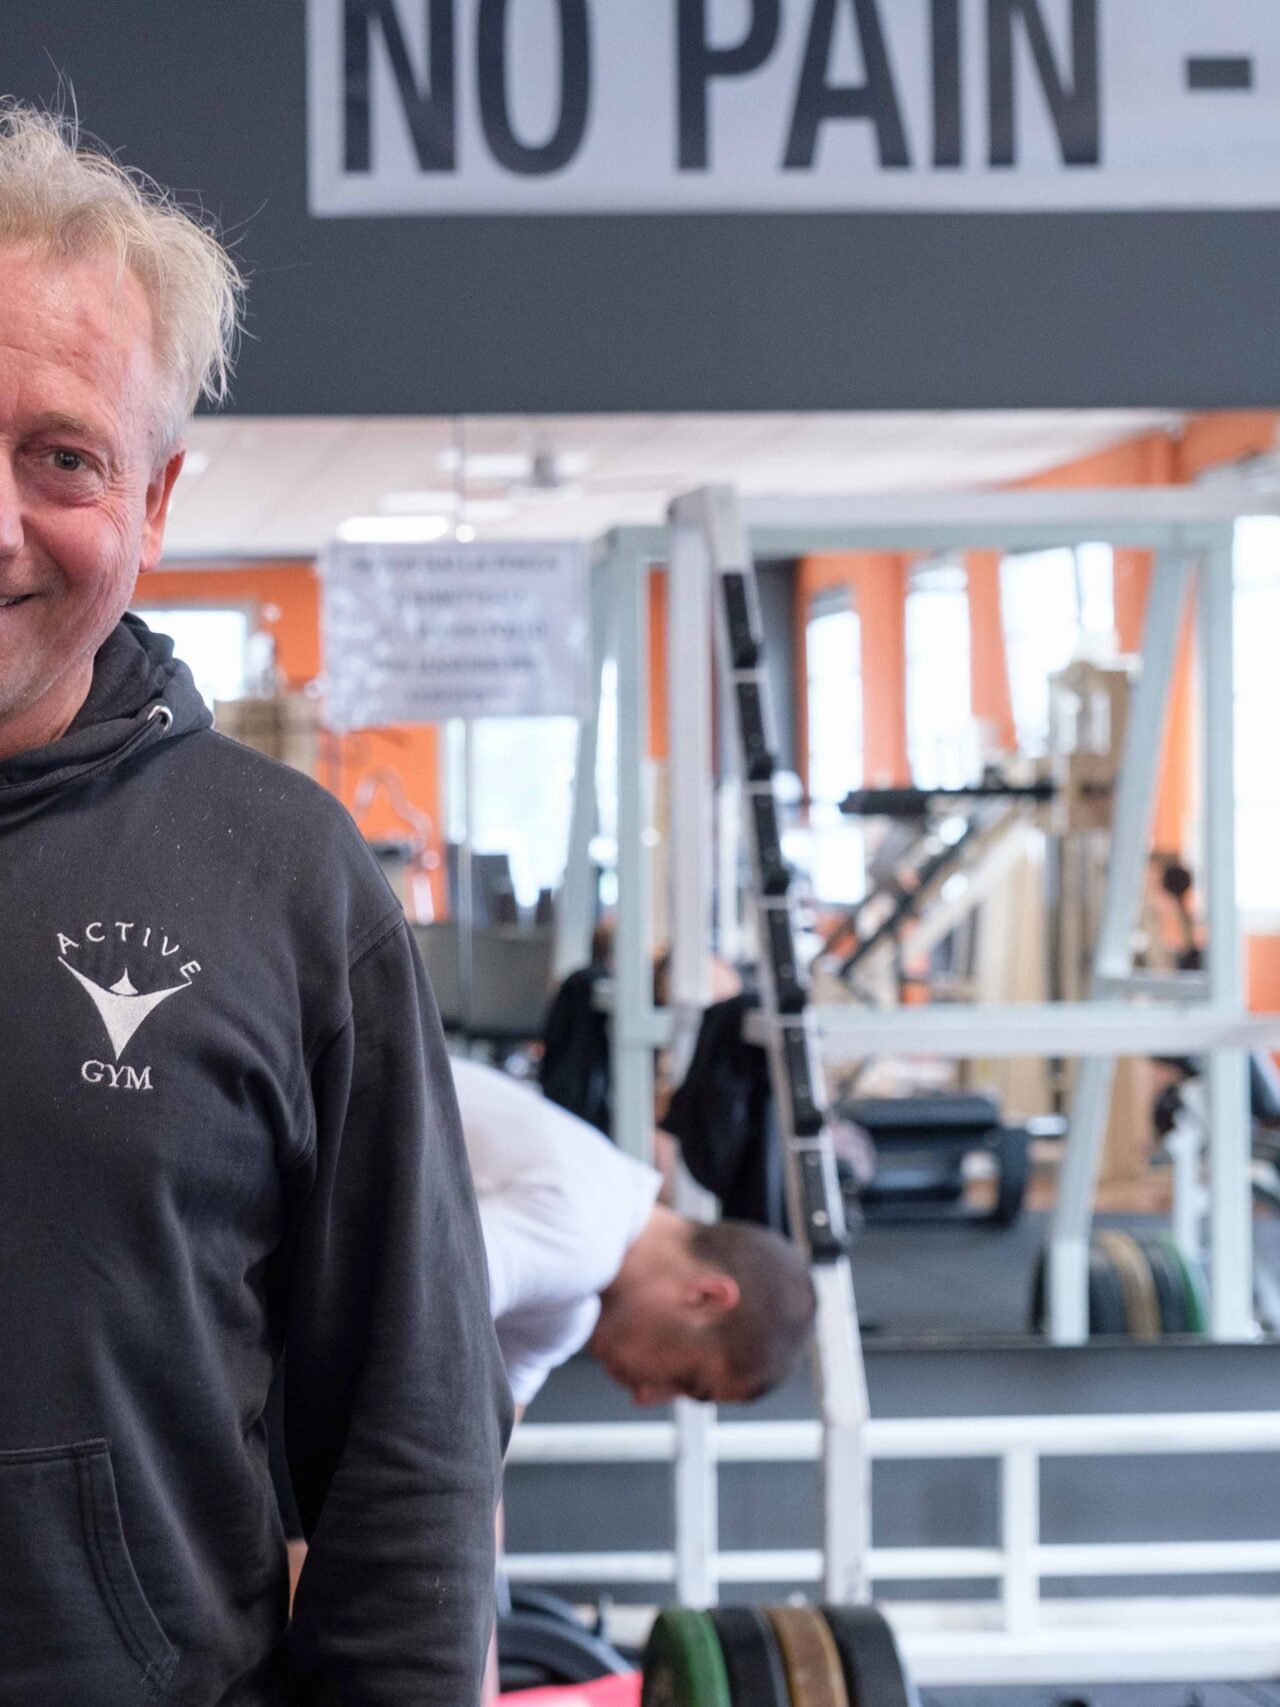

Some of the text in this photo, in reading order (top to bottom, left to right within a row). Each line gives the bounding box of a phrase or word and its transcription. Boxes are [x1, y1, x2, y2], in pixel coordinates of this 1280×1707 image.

[343, 0, 594, 175] NO
[678, 0, 1100, 170] PAIN
[57, 922, 202, 985] ACTIVE
[81, 1060, 154, 1090] GYM
